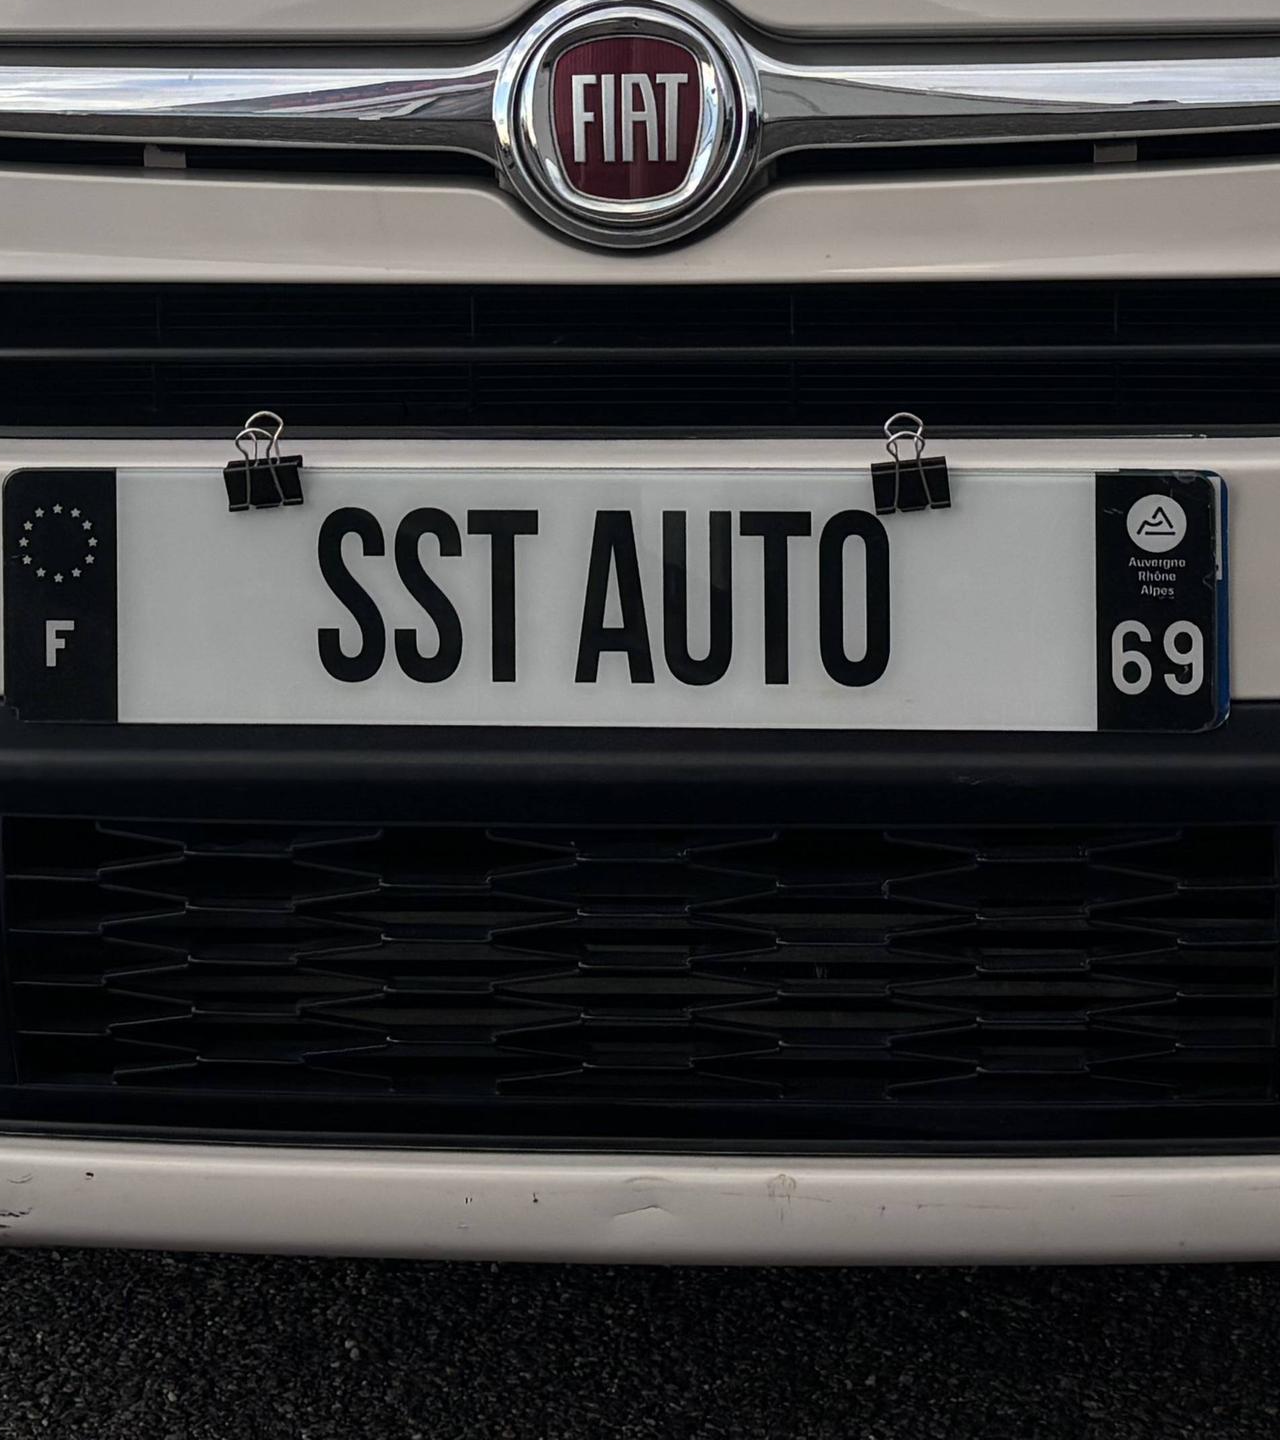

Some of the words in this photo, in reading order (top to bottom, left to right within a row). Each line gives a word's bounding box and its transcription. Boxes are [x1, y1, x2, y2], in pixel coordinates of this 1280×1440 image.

[571, 73, 688, 163] FIAT
[1128, 556, 1187, 570] Auvergne
[1137, 569, 1177, 582] Rhône
[317, 506, 539, 683] SST
[574, 508, 891, 688] AUTO
[1140, 584, 1175, 597] Alpes
[45, 620, 75, 668] F
[1111, 619, 1205, 696] 69
